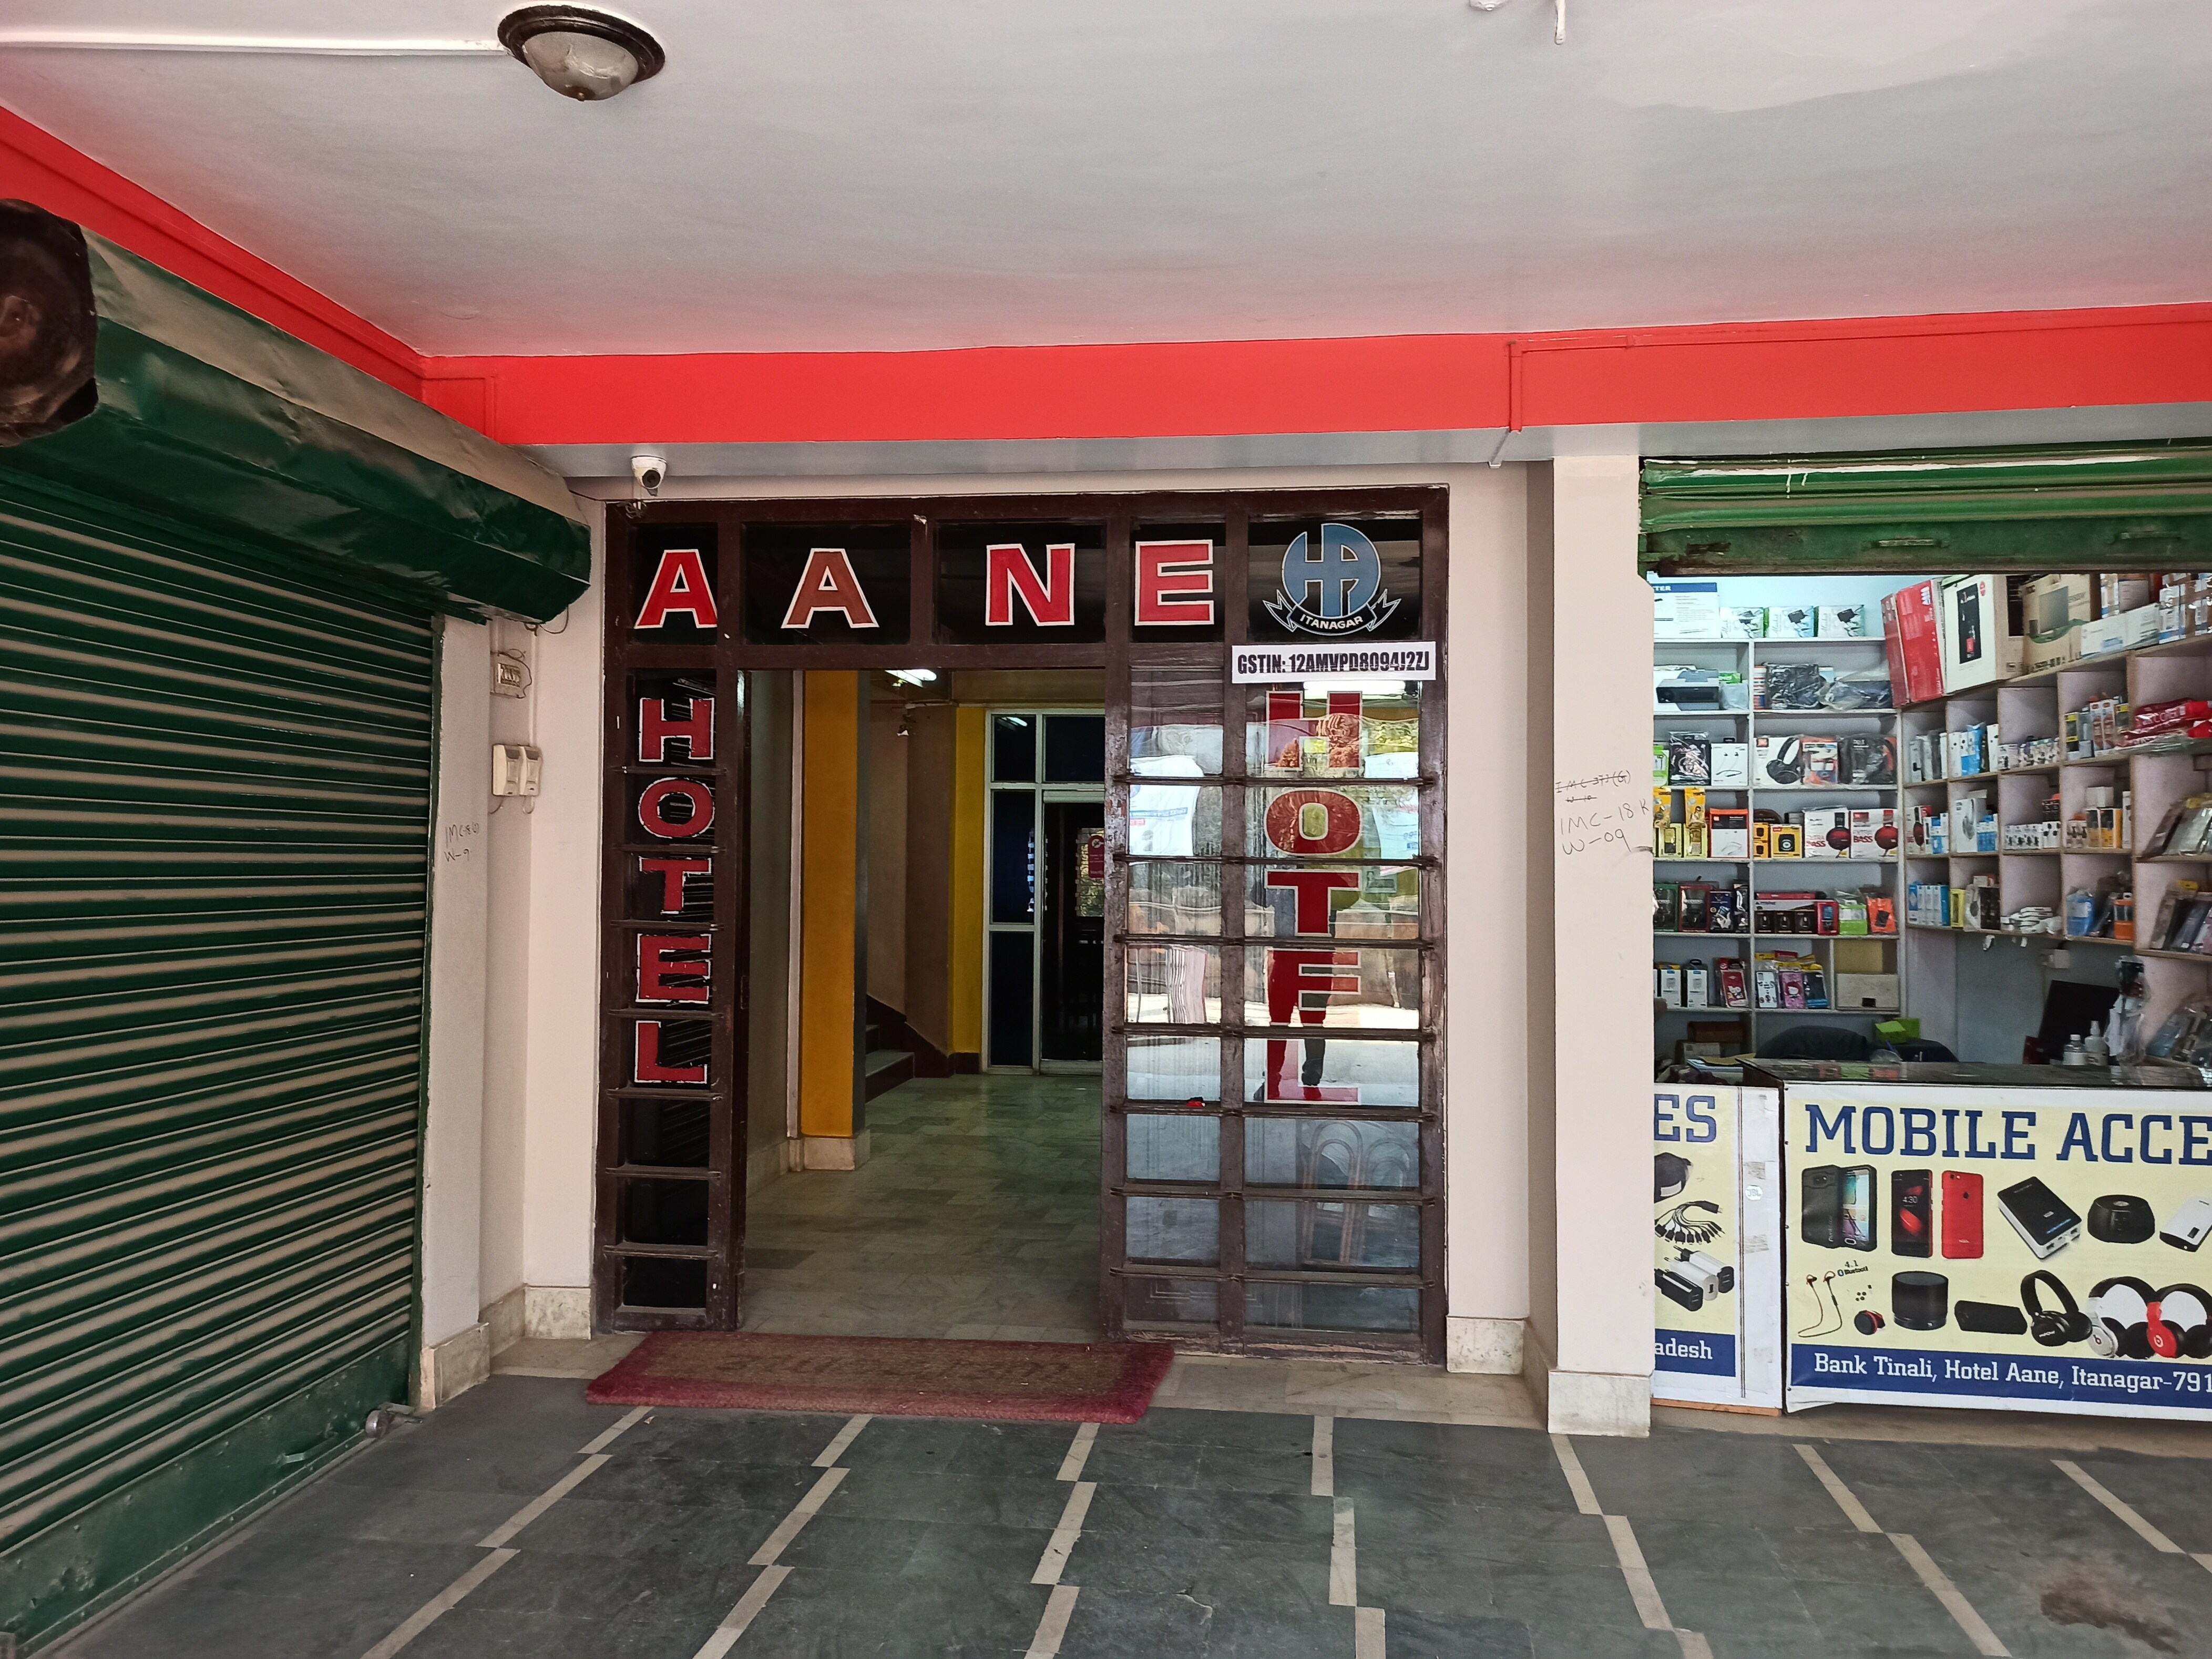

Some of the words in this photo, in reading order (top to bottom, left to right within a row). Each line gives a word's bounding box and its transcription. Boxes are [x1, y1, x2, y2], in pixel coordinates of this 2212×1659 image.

[1299, 613, 1364, 630] ITANAGAR
[1237, 654, 1286, 674] GSTIN:
[634, 697, 715, 1084] HOTEL
[1264, 690, 1363, 1105] HOTEL
[1654, 1093, 1717, 1143] ES
[1805, 1104, 2036, 1161] MOBILE
[2056, 1112, 2212, 1166] ACCE
[1814, 1353, 1868, 1375] Bank
[1873, 1355, 1938, 1383] Tinali,
[1944, 1358, 1999, 1381] Hotel
[2005, 1362, 2065, 1389] Aane,
